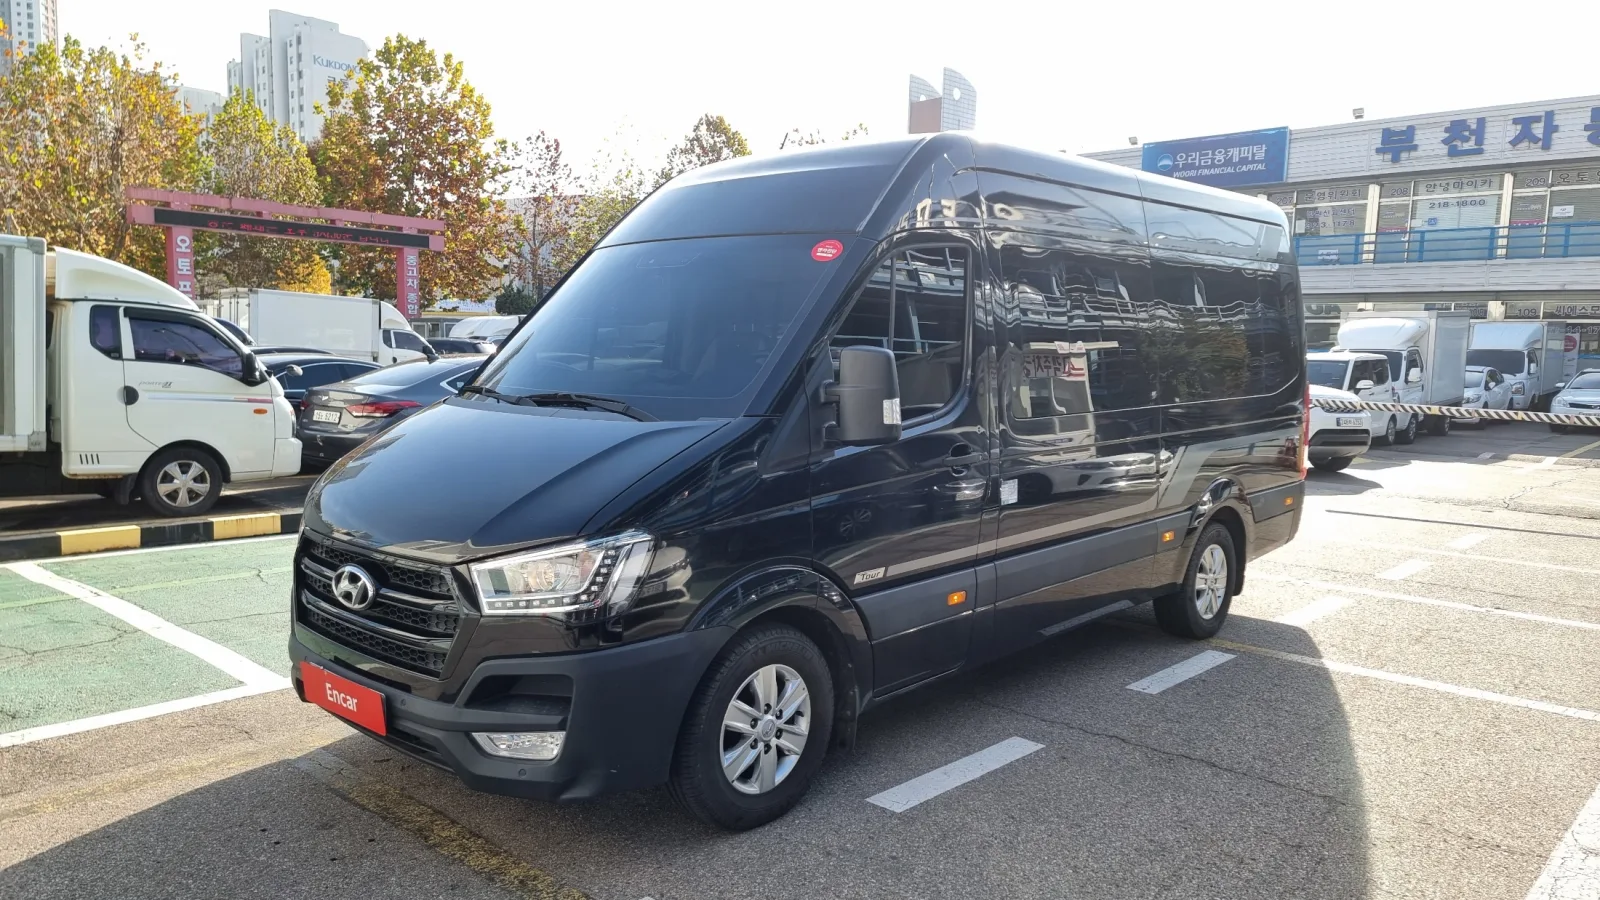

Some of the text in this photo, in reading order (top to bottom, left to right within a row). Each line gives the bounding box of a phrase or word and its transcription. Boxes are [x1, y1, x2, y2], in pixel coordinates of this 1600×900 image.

[1174, 144, 1267, 168] 우리금융캐피탈
[1173, 163, 1266, 178] WOORI FINANCIAL CAPITAL
[1425, 179, 1493, 192] 안녕마이카
[1525, 177, 1546, 187] 209
[1390, 187, 1409, 196] 208
[1428, 199, 1486, 209] 218-1800
[1517, 308, 1537, 317] 109
[861, 571, 881, 581] Tour
[325, 682, 358, 712] Encar
